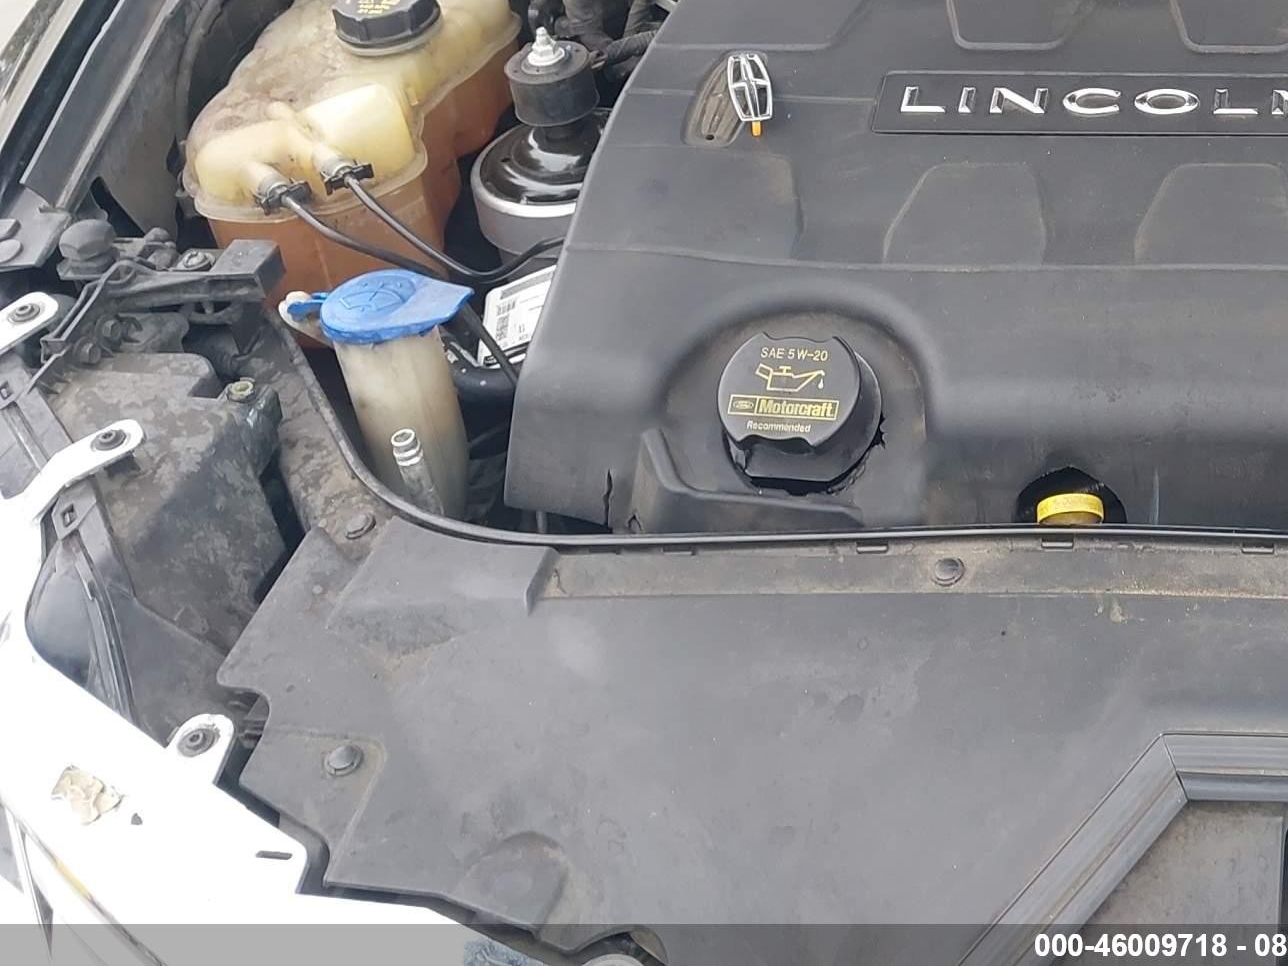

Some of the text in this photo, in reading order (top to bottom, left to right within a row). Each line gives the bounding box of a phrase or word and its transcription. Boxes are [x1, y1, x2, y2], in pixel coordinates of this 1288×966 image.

[760, 346, 785, 360] SAE
[758, 398, 834, 417] Motorcraft
[746, 420, 811, 434] Recommended
